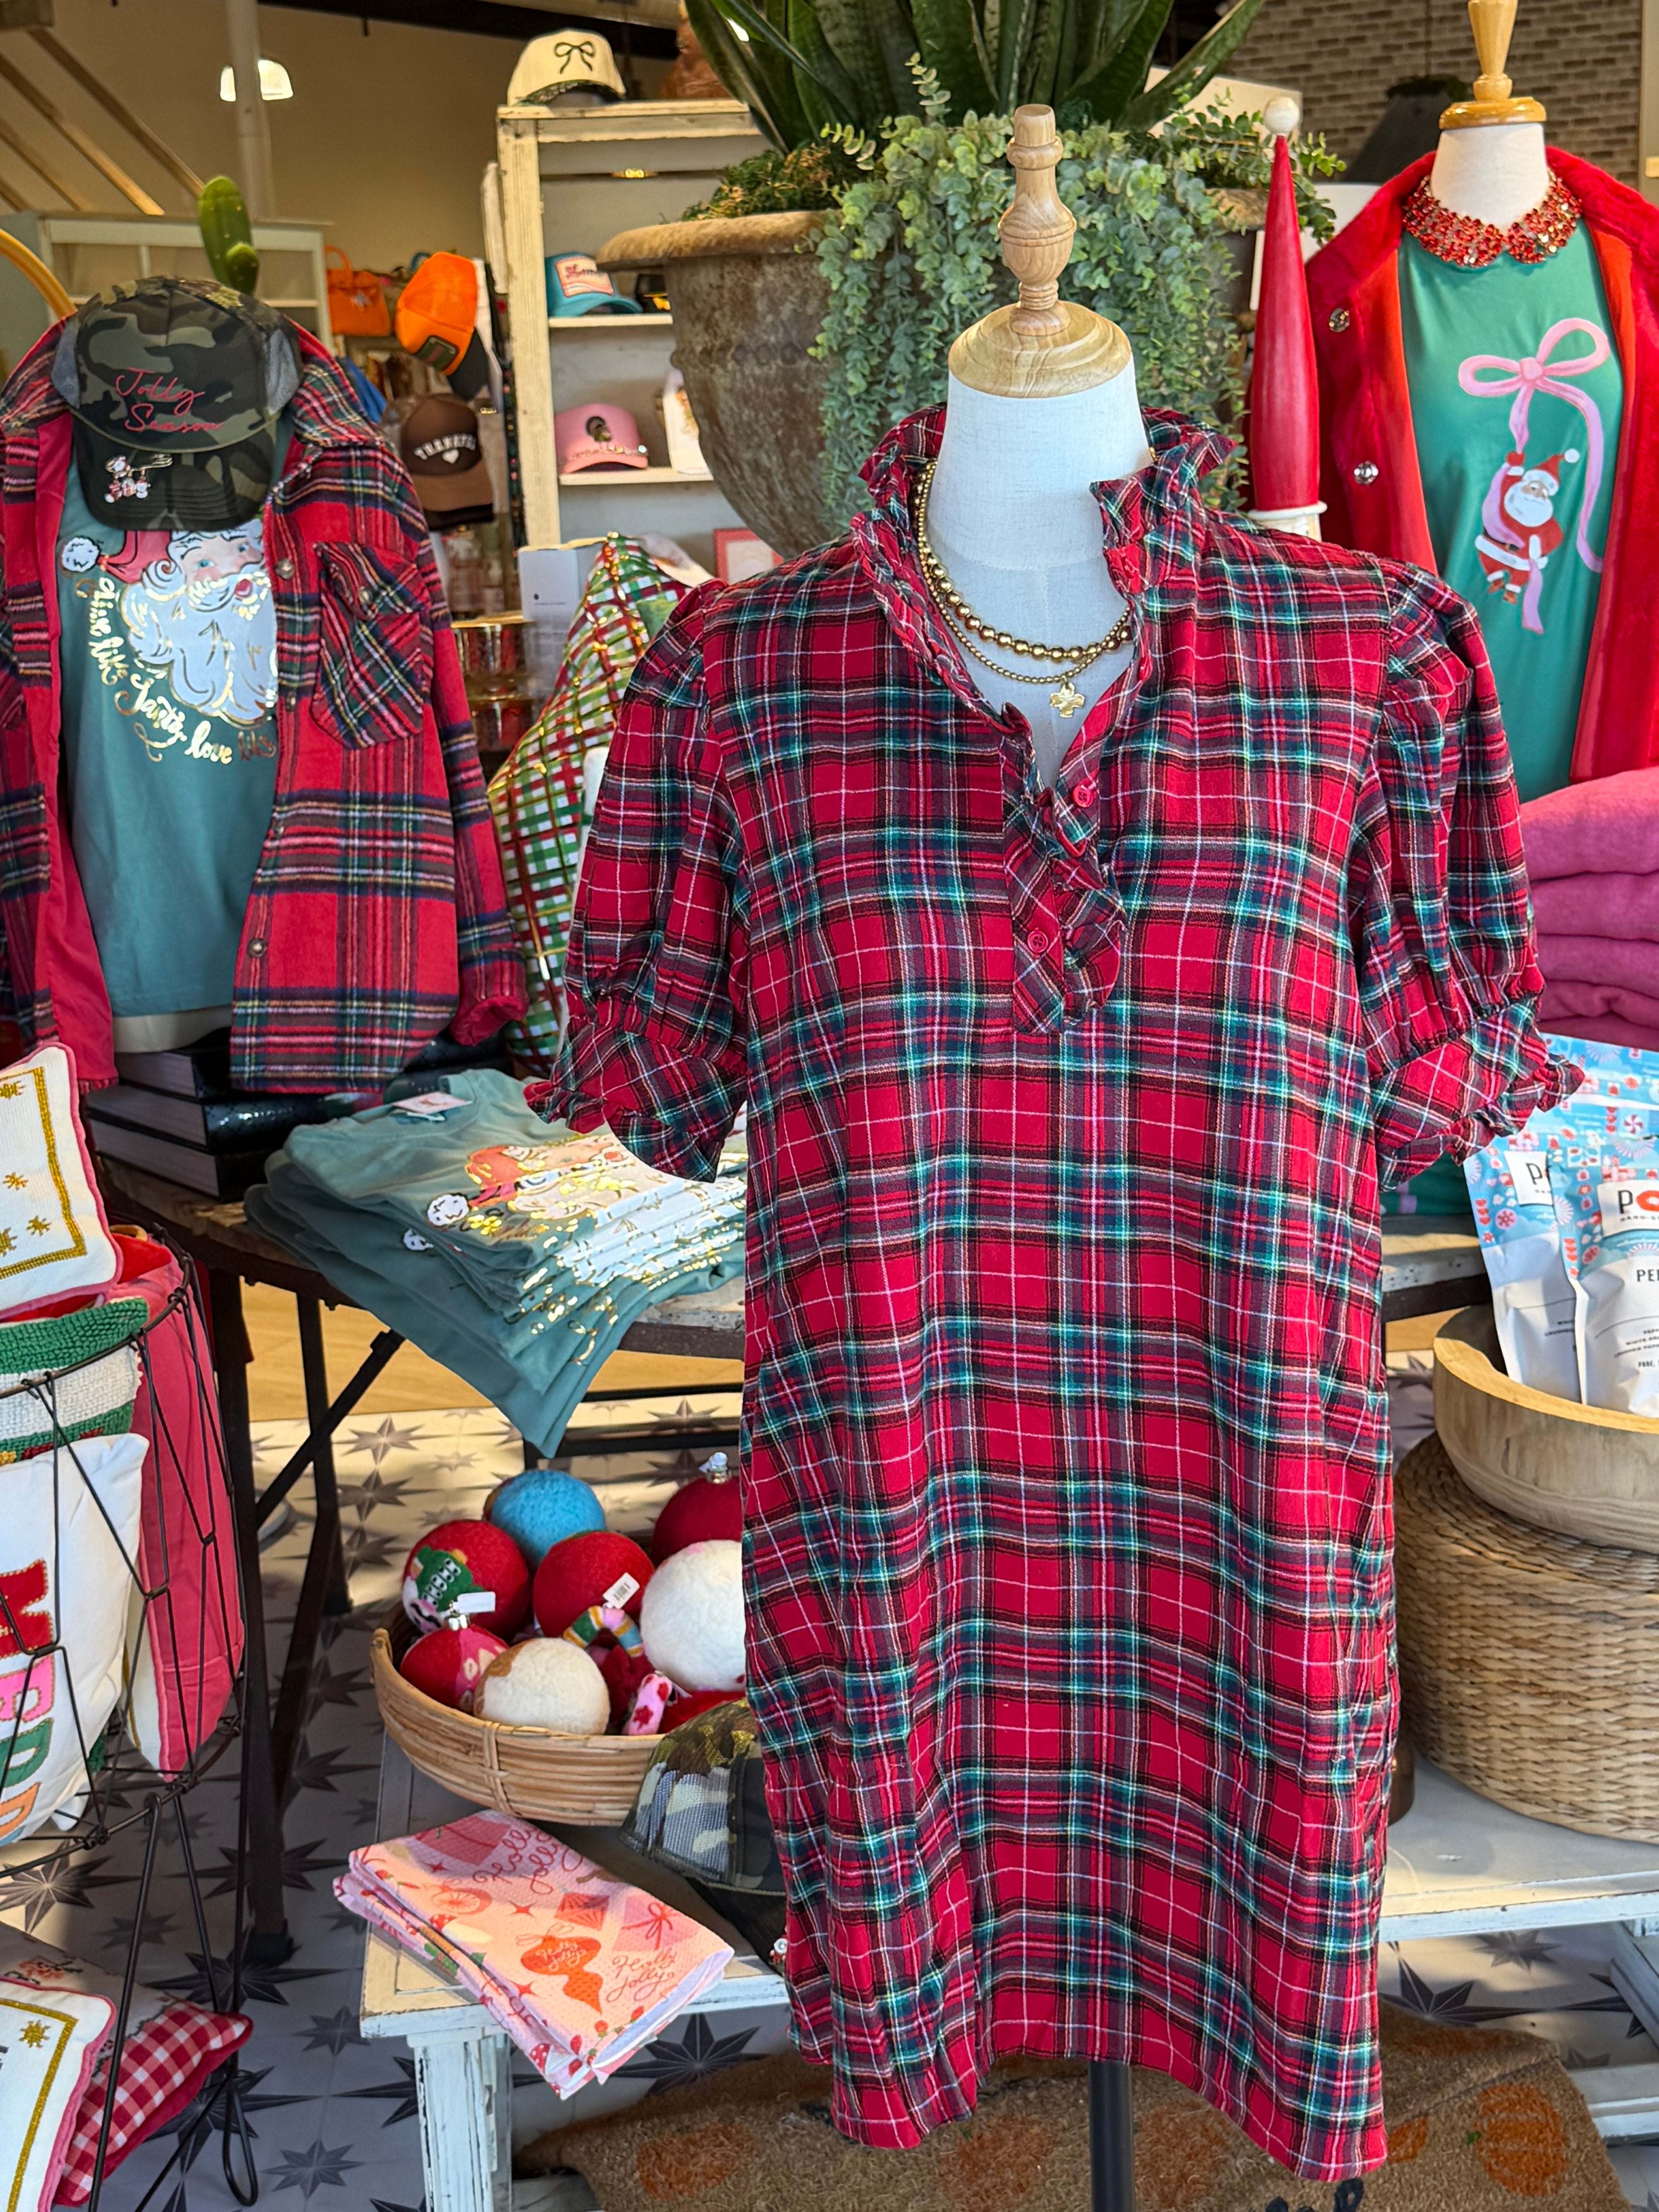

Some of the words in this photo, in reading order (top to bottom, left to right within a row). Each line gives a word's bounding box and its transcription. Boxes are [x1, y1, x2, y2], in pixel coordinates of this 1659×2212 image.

[115, 367, 205, 417] Jolly
[124, 402, 224, 433] Season
[184, 720, 233, 764] love
